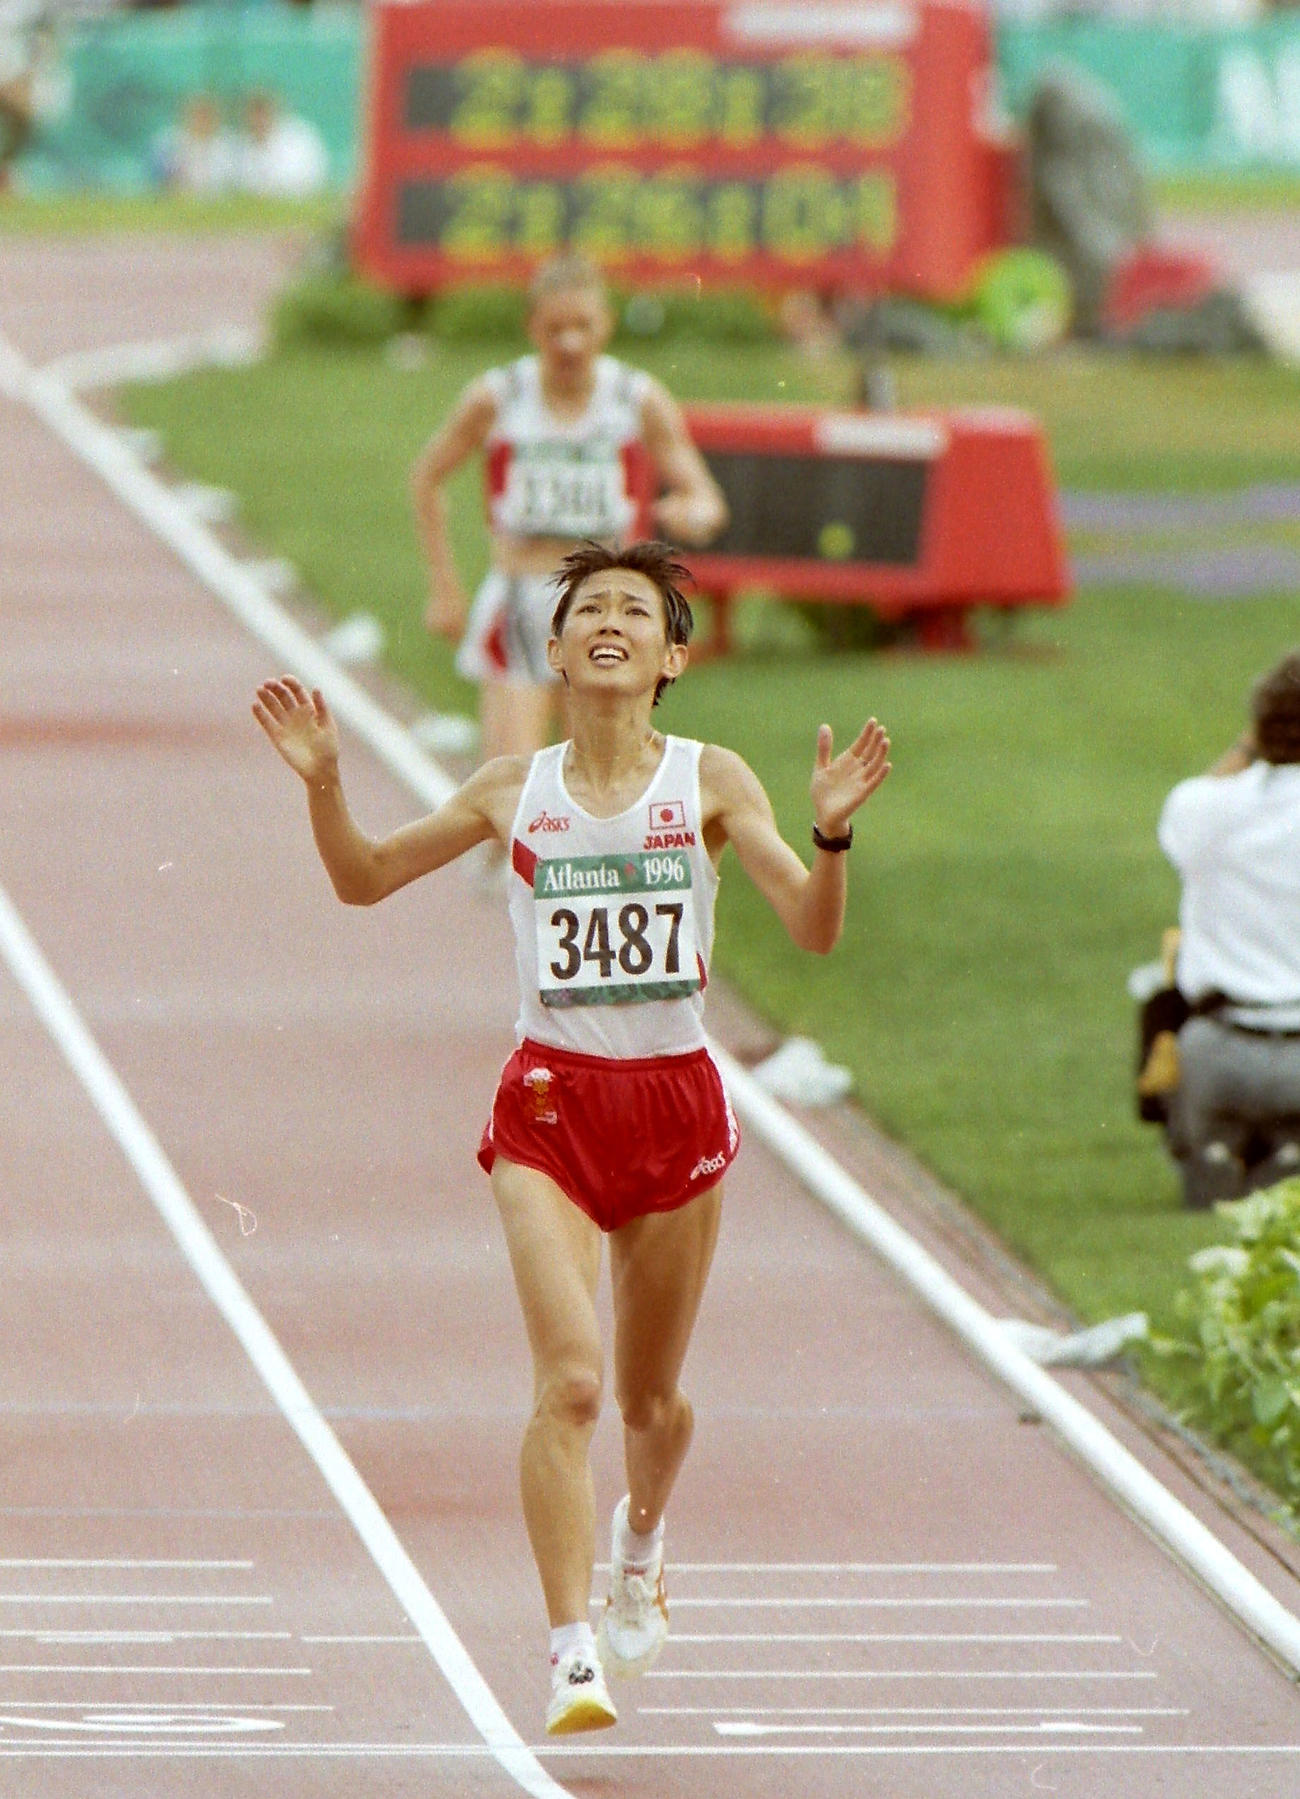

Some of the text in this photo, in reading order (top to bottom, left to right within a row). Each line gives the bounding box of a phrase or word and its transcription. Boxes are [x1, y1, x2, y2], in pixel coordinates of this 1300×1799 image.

[643, 832, 696, 850] JAPAN
[543, 855, 684, 892] Atlanta 1996
[550, 902, 685, 980] 3487
